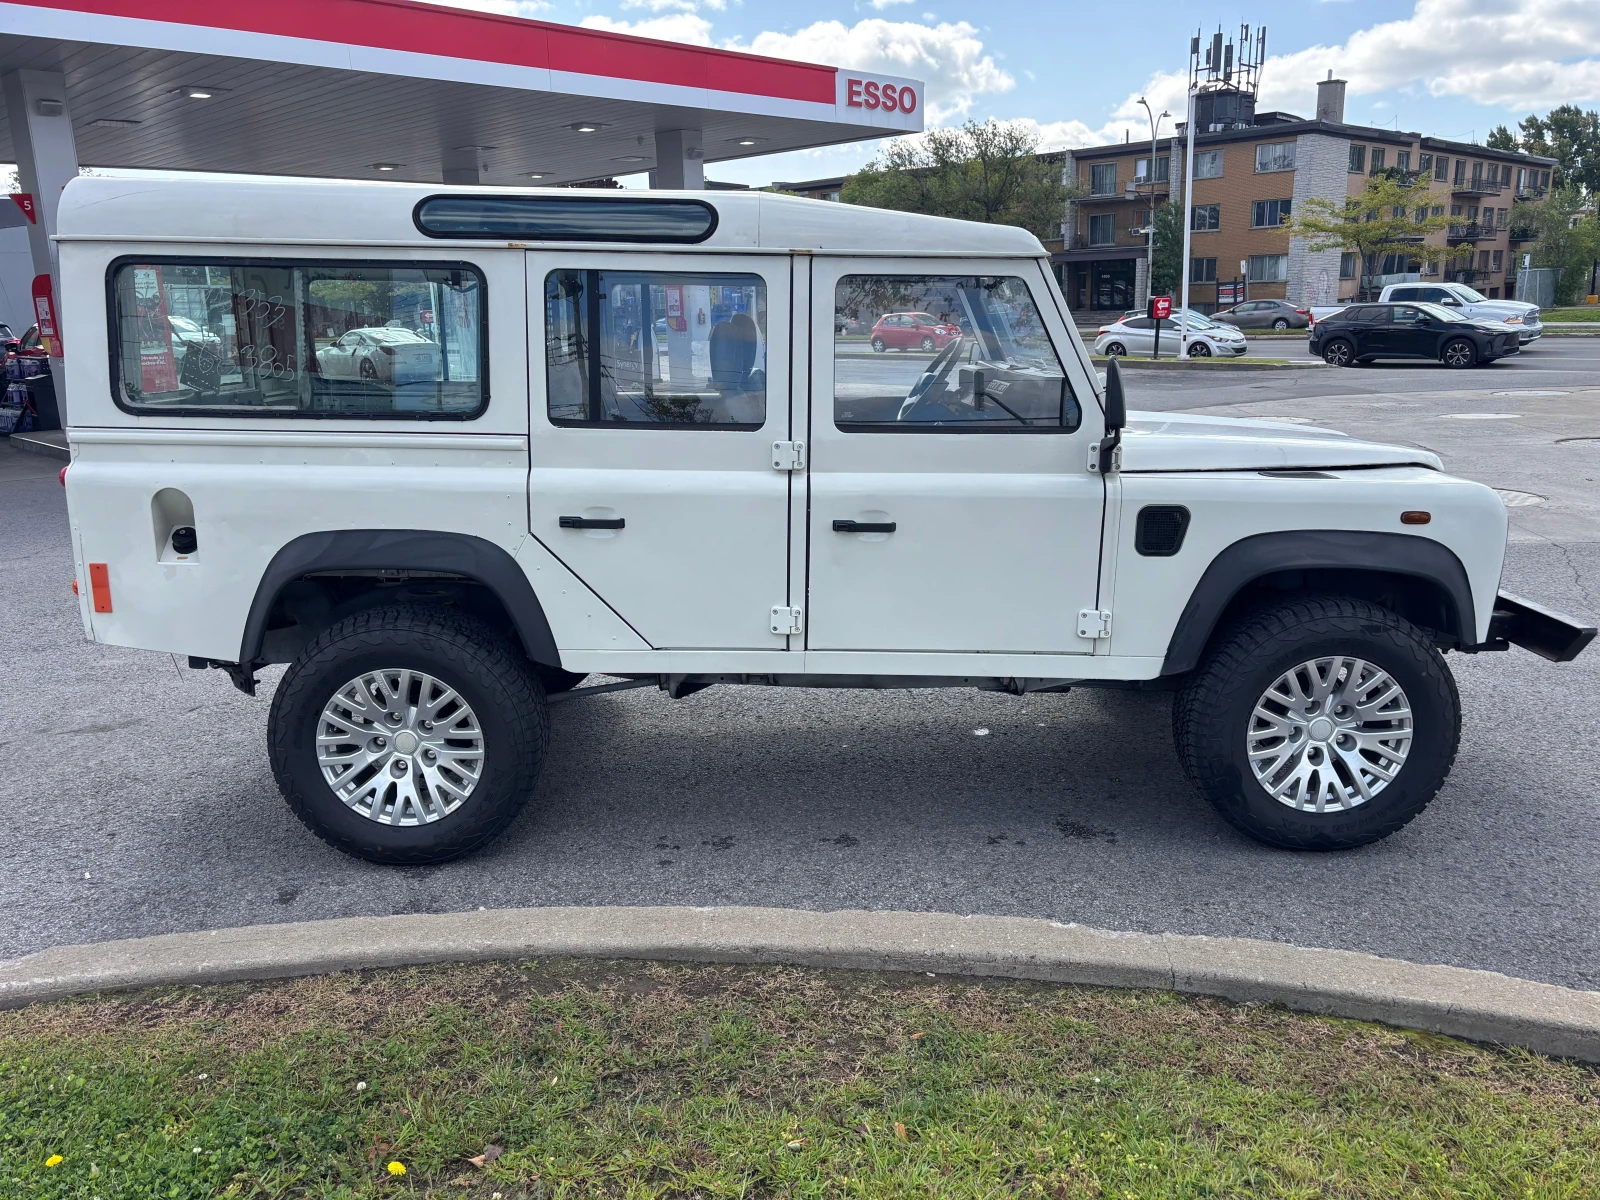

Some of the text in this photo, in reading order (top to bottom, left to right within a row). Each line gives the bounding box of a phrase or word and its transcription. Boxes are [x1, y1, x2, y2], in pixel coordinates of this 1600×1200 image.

[846, 78, 917, 115] ESSO
[24, 200, 31, 211] 5
[616, 360, 639, 370] Synergy
